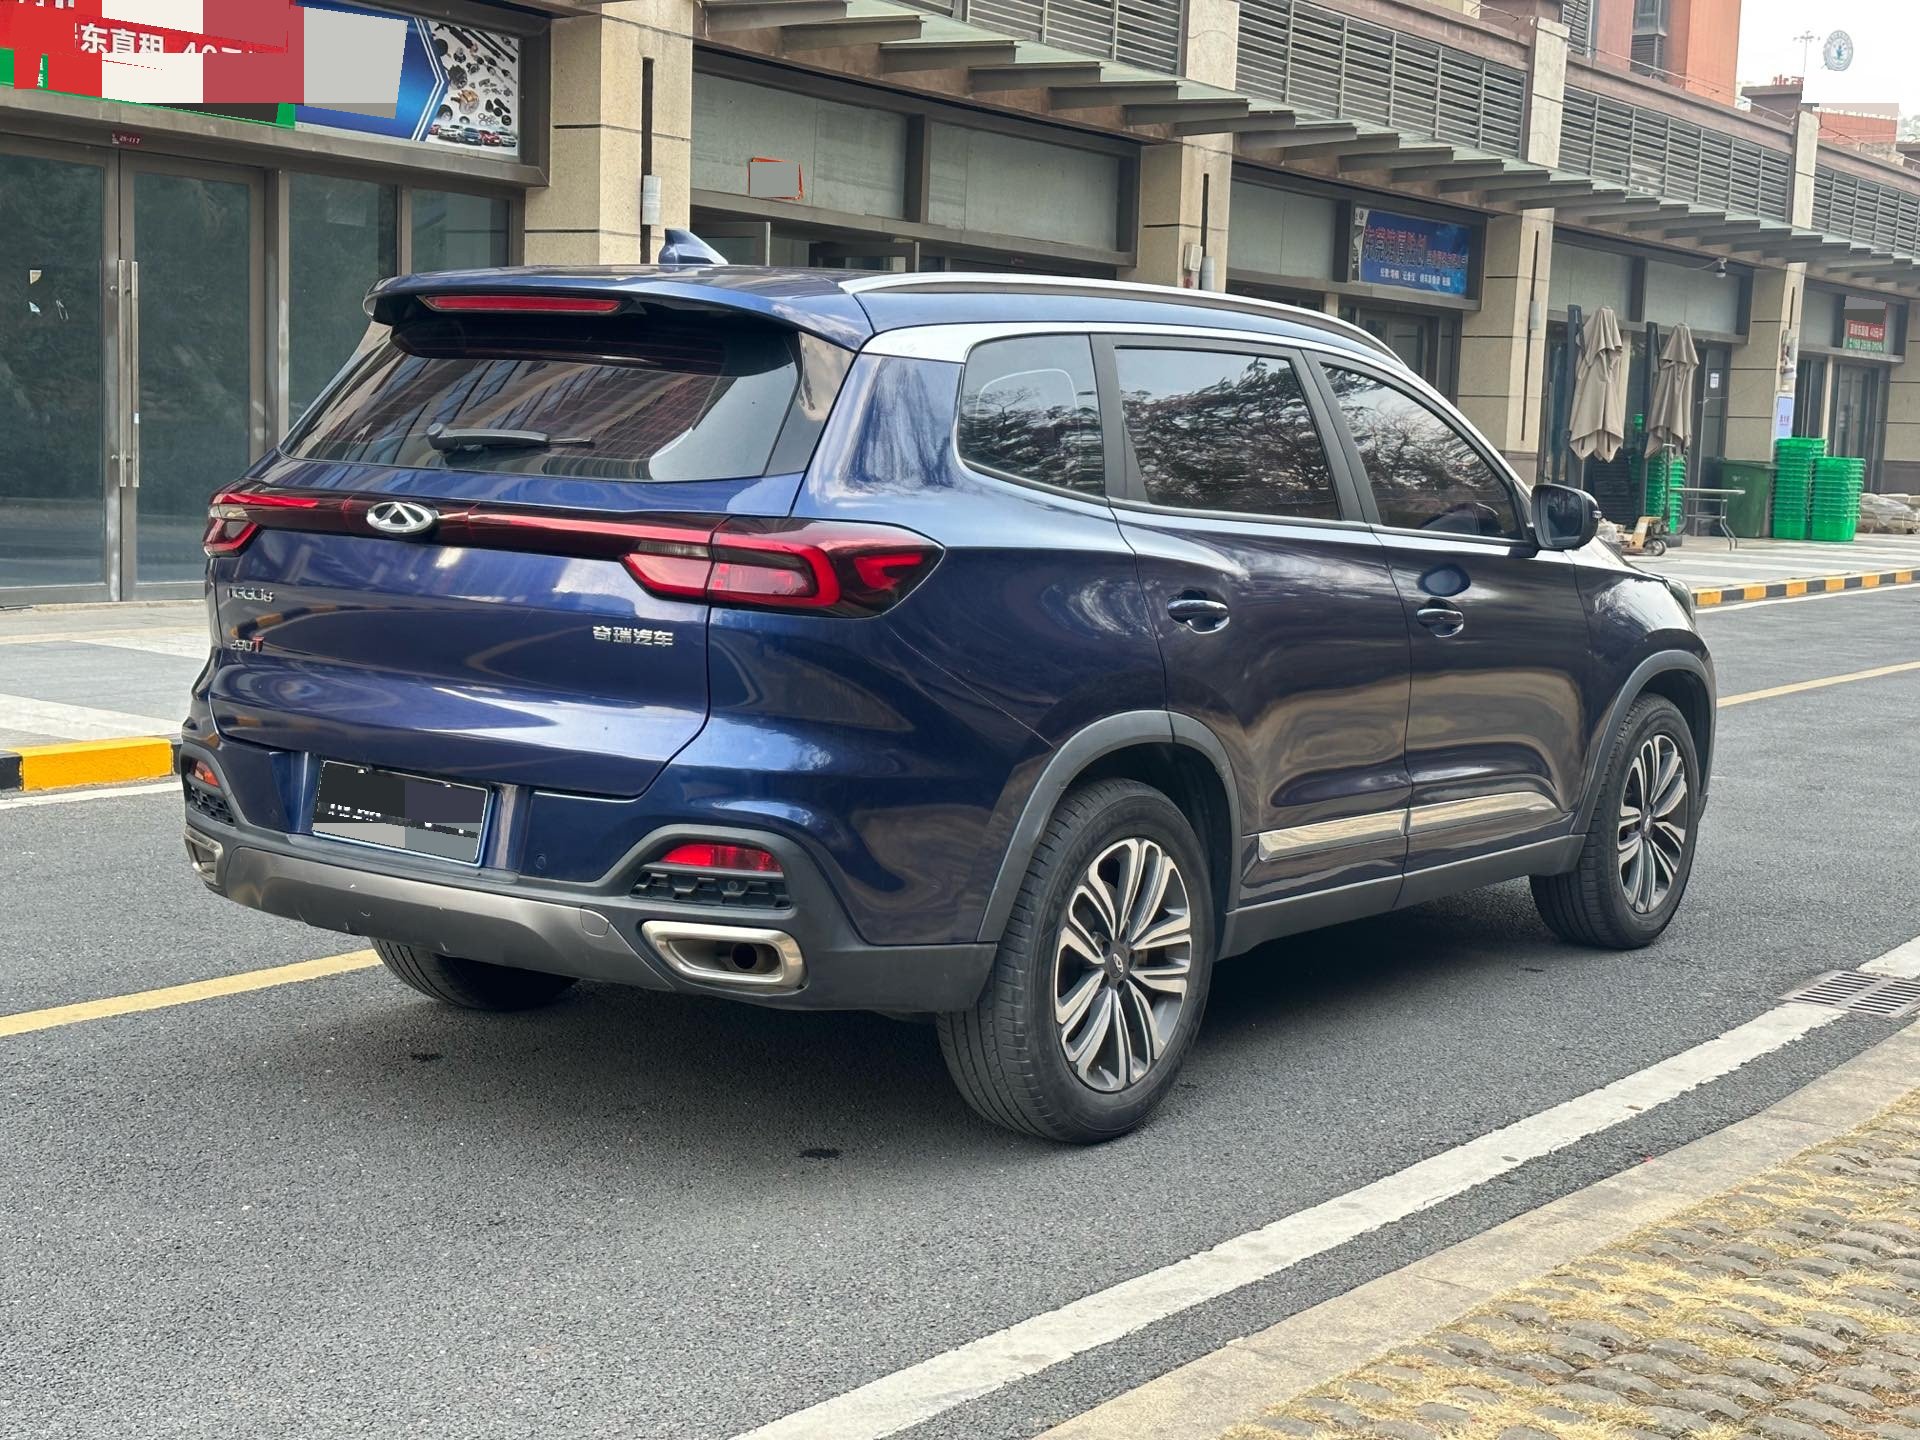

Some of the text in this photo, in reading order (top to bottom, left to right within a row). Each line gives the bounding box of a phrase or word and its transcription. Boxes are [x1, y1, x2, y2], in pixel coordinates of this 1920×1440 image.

[75, 22, 164, 54] 东直租
[592, 625, 674, 647] 奇瑞汽车
